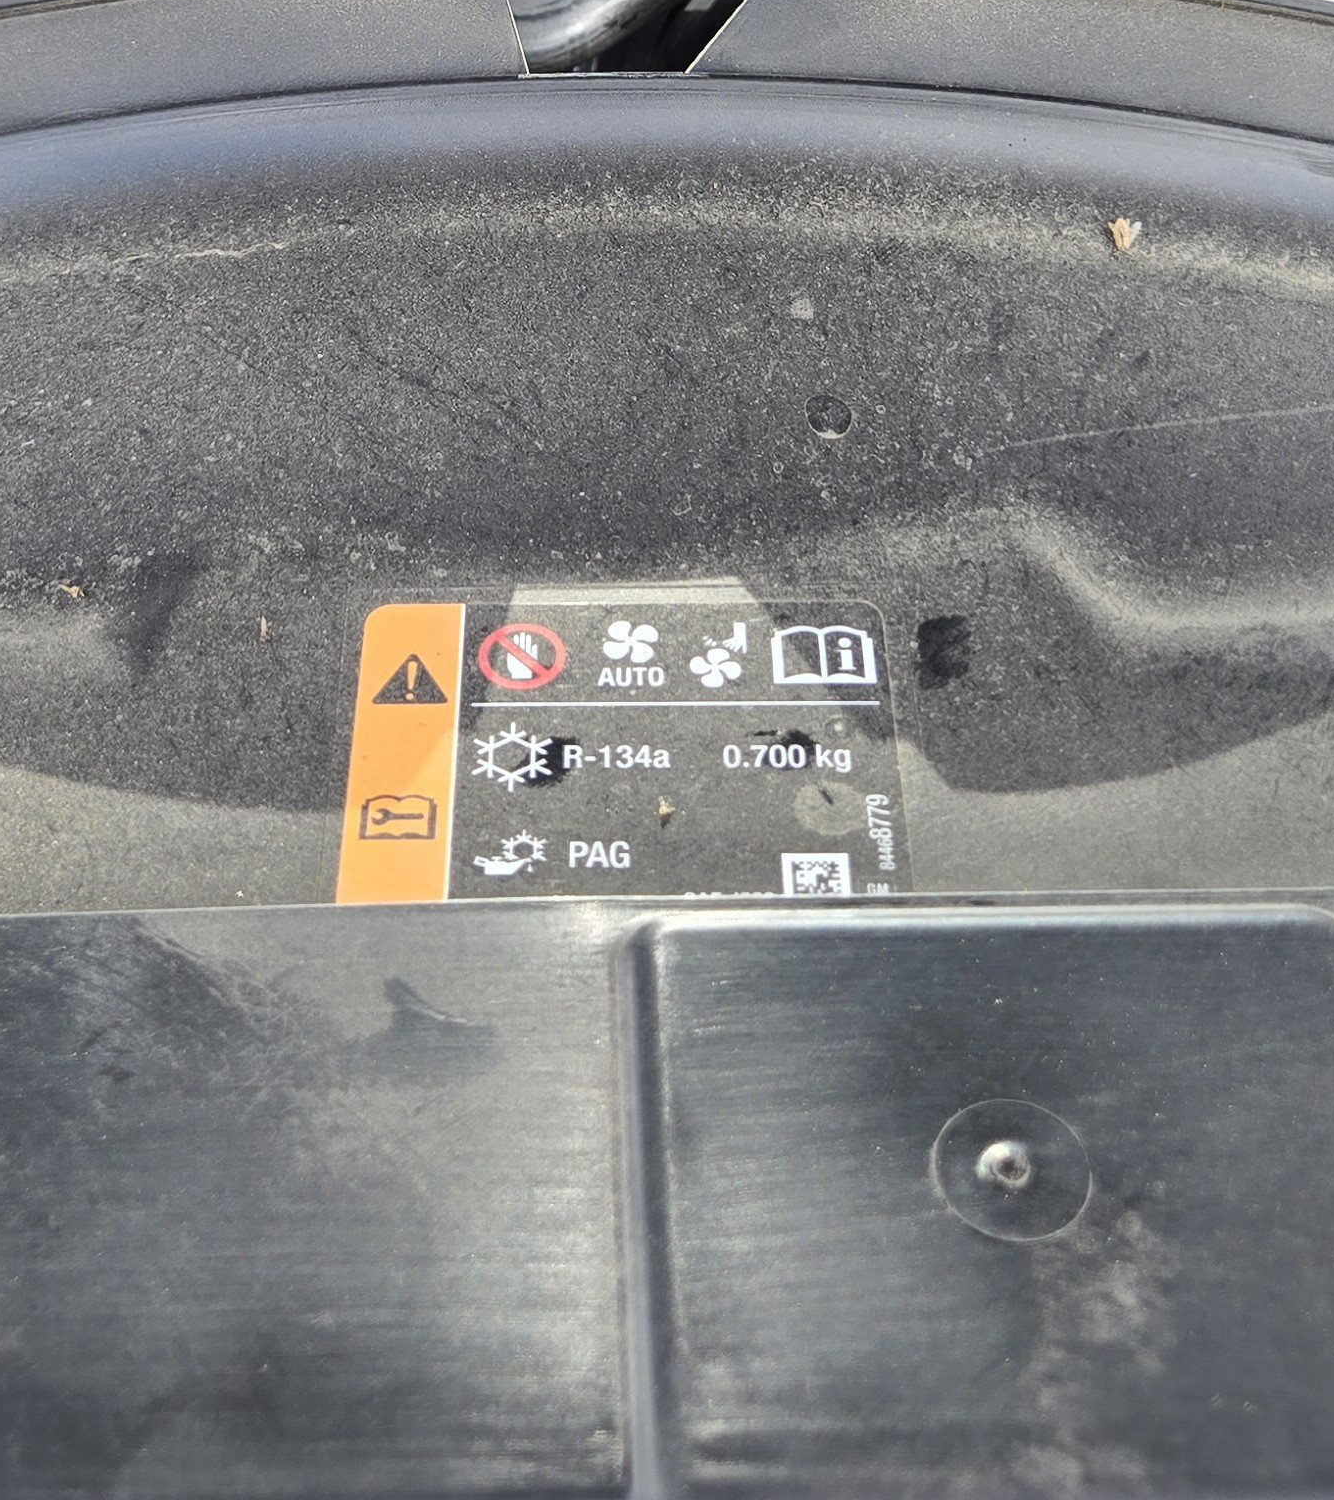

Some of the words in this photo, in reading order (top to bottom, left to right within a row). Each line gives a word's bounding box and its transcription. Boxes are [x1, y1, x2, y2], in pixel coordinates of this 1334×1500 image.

[597, 667, 665, 687] AUTO
[562, 744, 672, 769] R-134a
[722, 744, 807, 769] 0.700
[815, 744, 852, 773] kg
[569, 840, 631, 869] PAG
